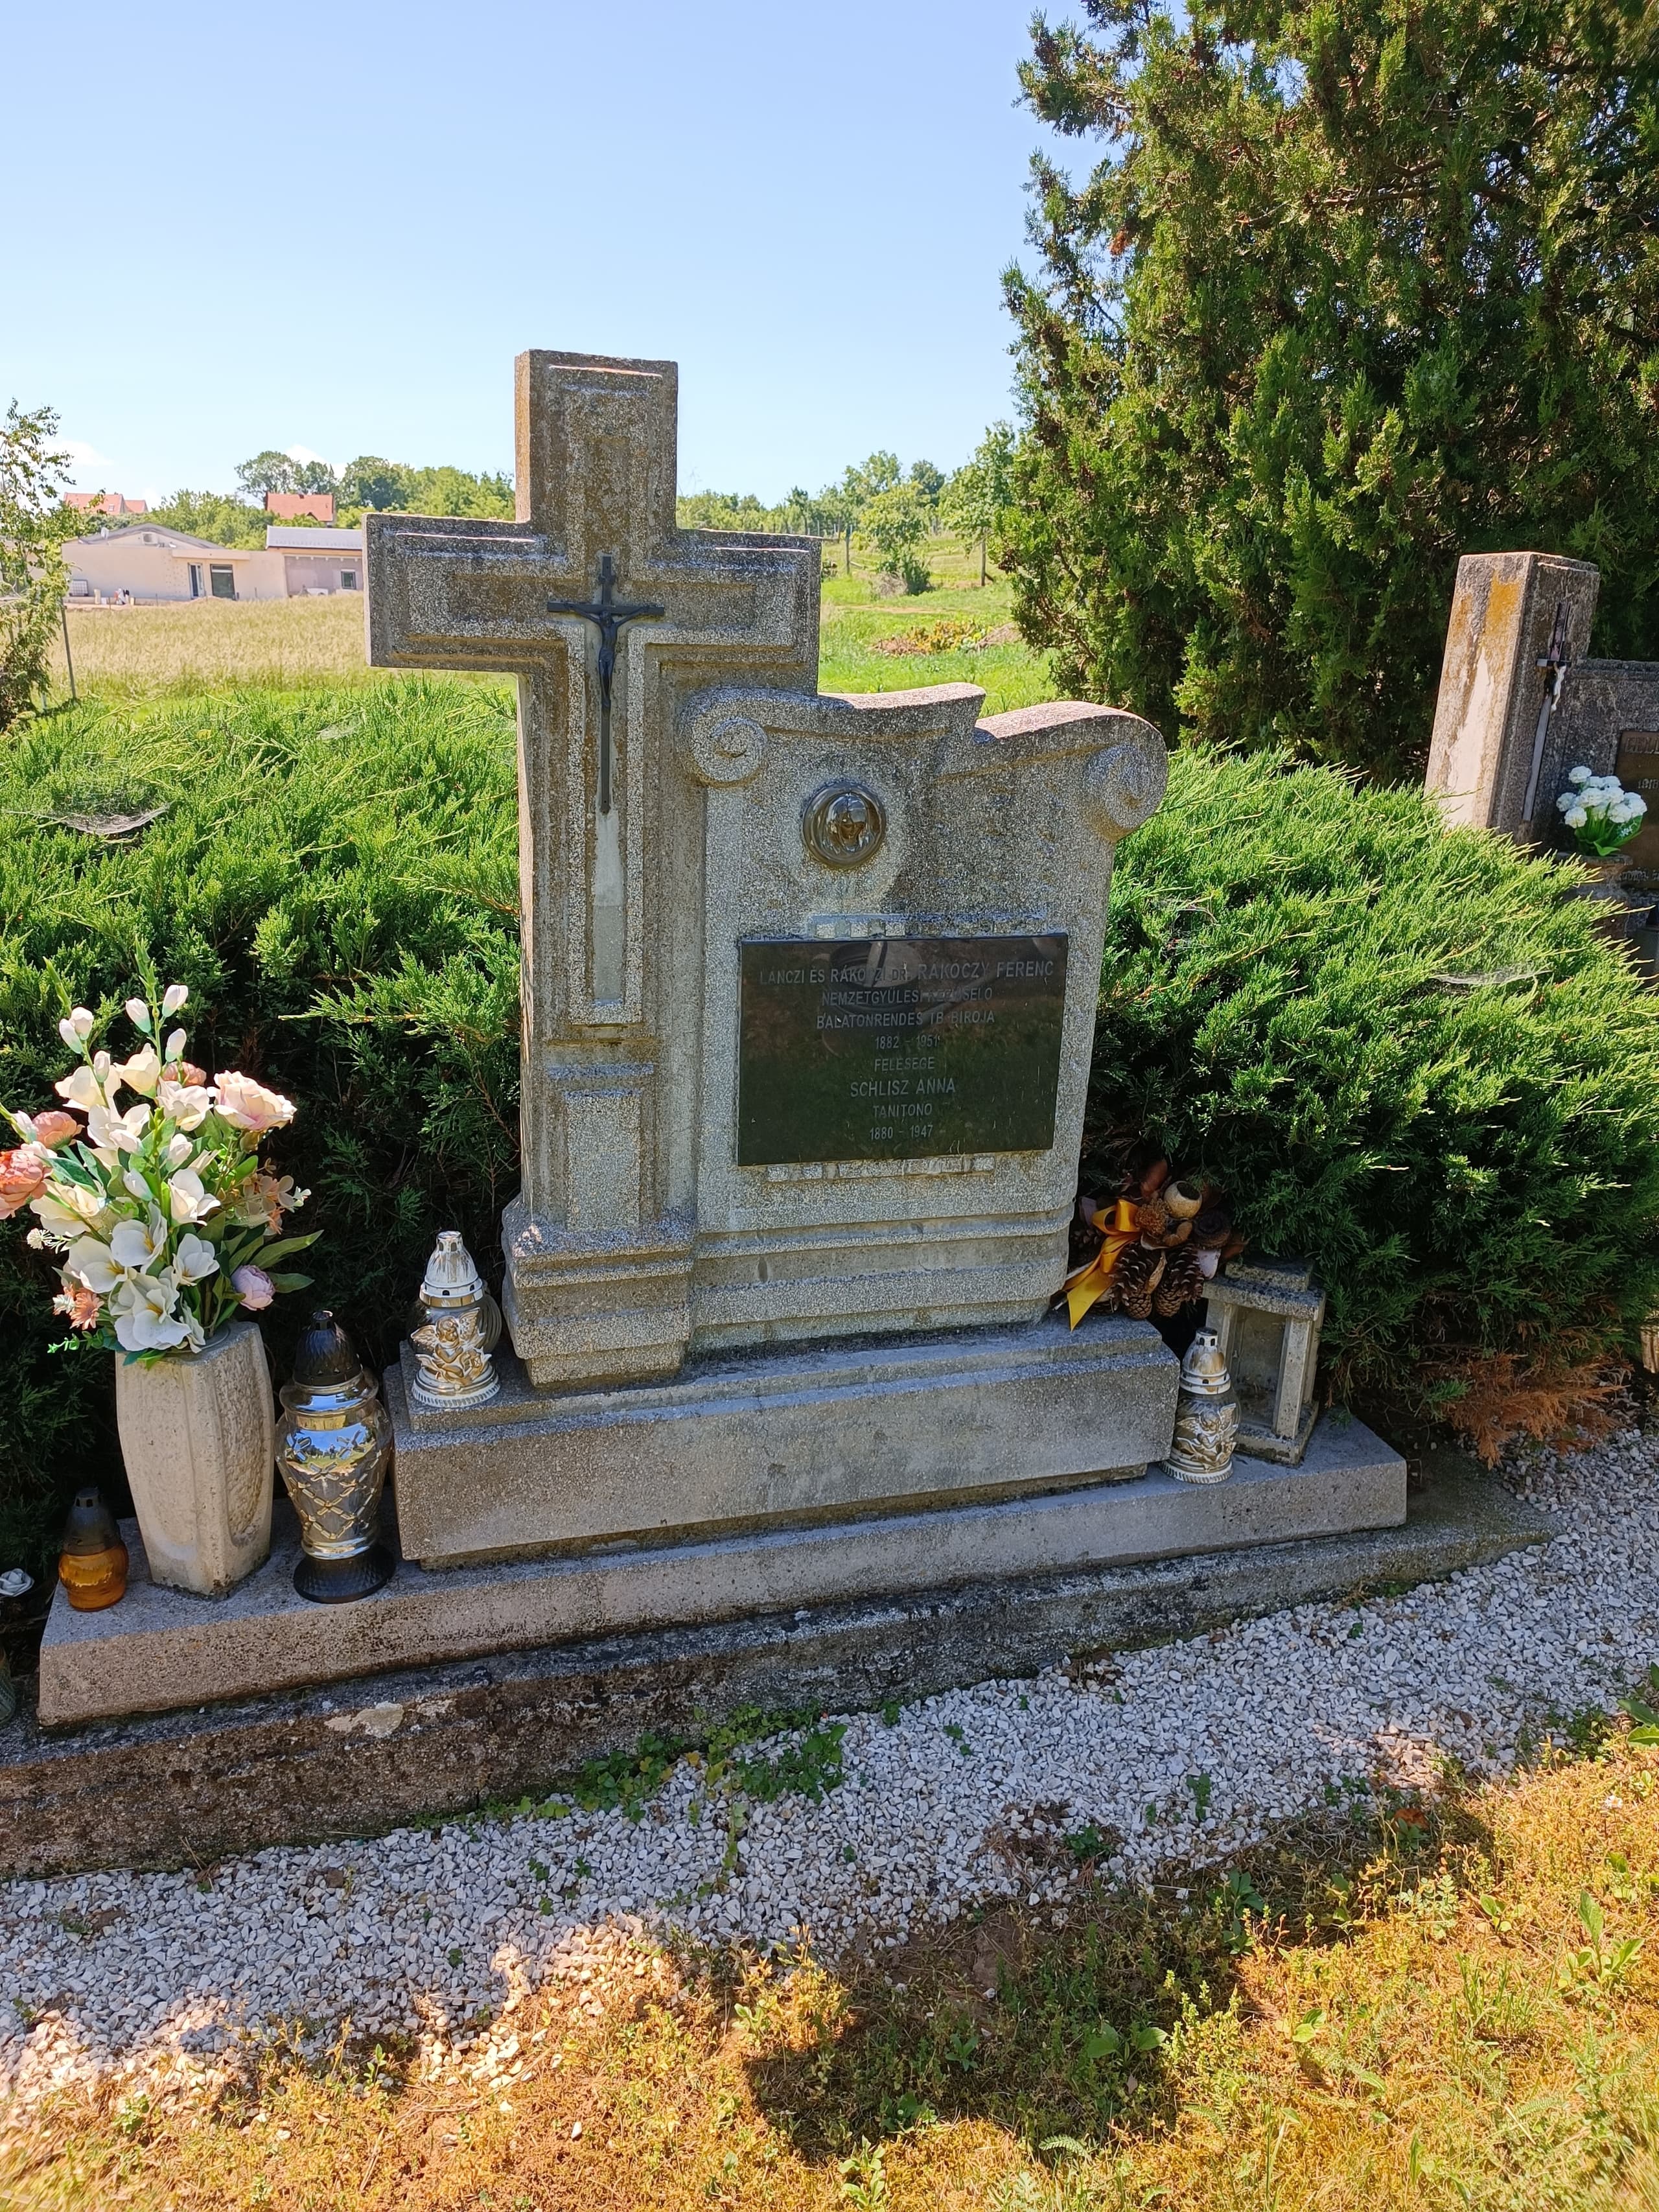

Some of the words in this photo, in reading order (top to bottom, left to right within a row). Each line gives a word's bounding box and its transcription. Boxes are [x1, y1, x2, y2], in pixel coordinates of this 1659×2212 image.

[997, 960, 1053, 977] FERENC
[875, 1036, 899, 1049] 1882
[916, 1034, 938, 1047] 1951
[850, 1080, 909, 1097] SCHLISZ
[916, 1078, 956, 1095] ANNA
[870, 1126, 893, 1141] 1880
[910, 1124, 933, 1138] 1947
